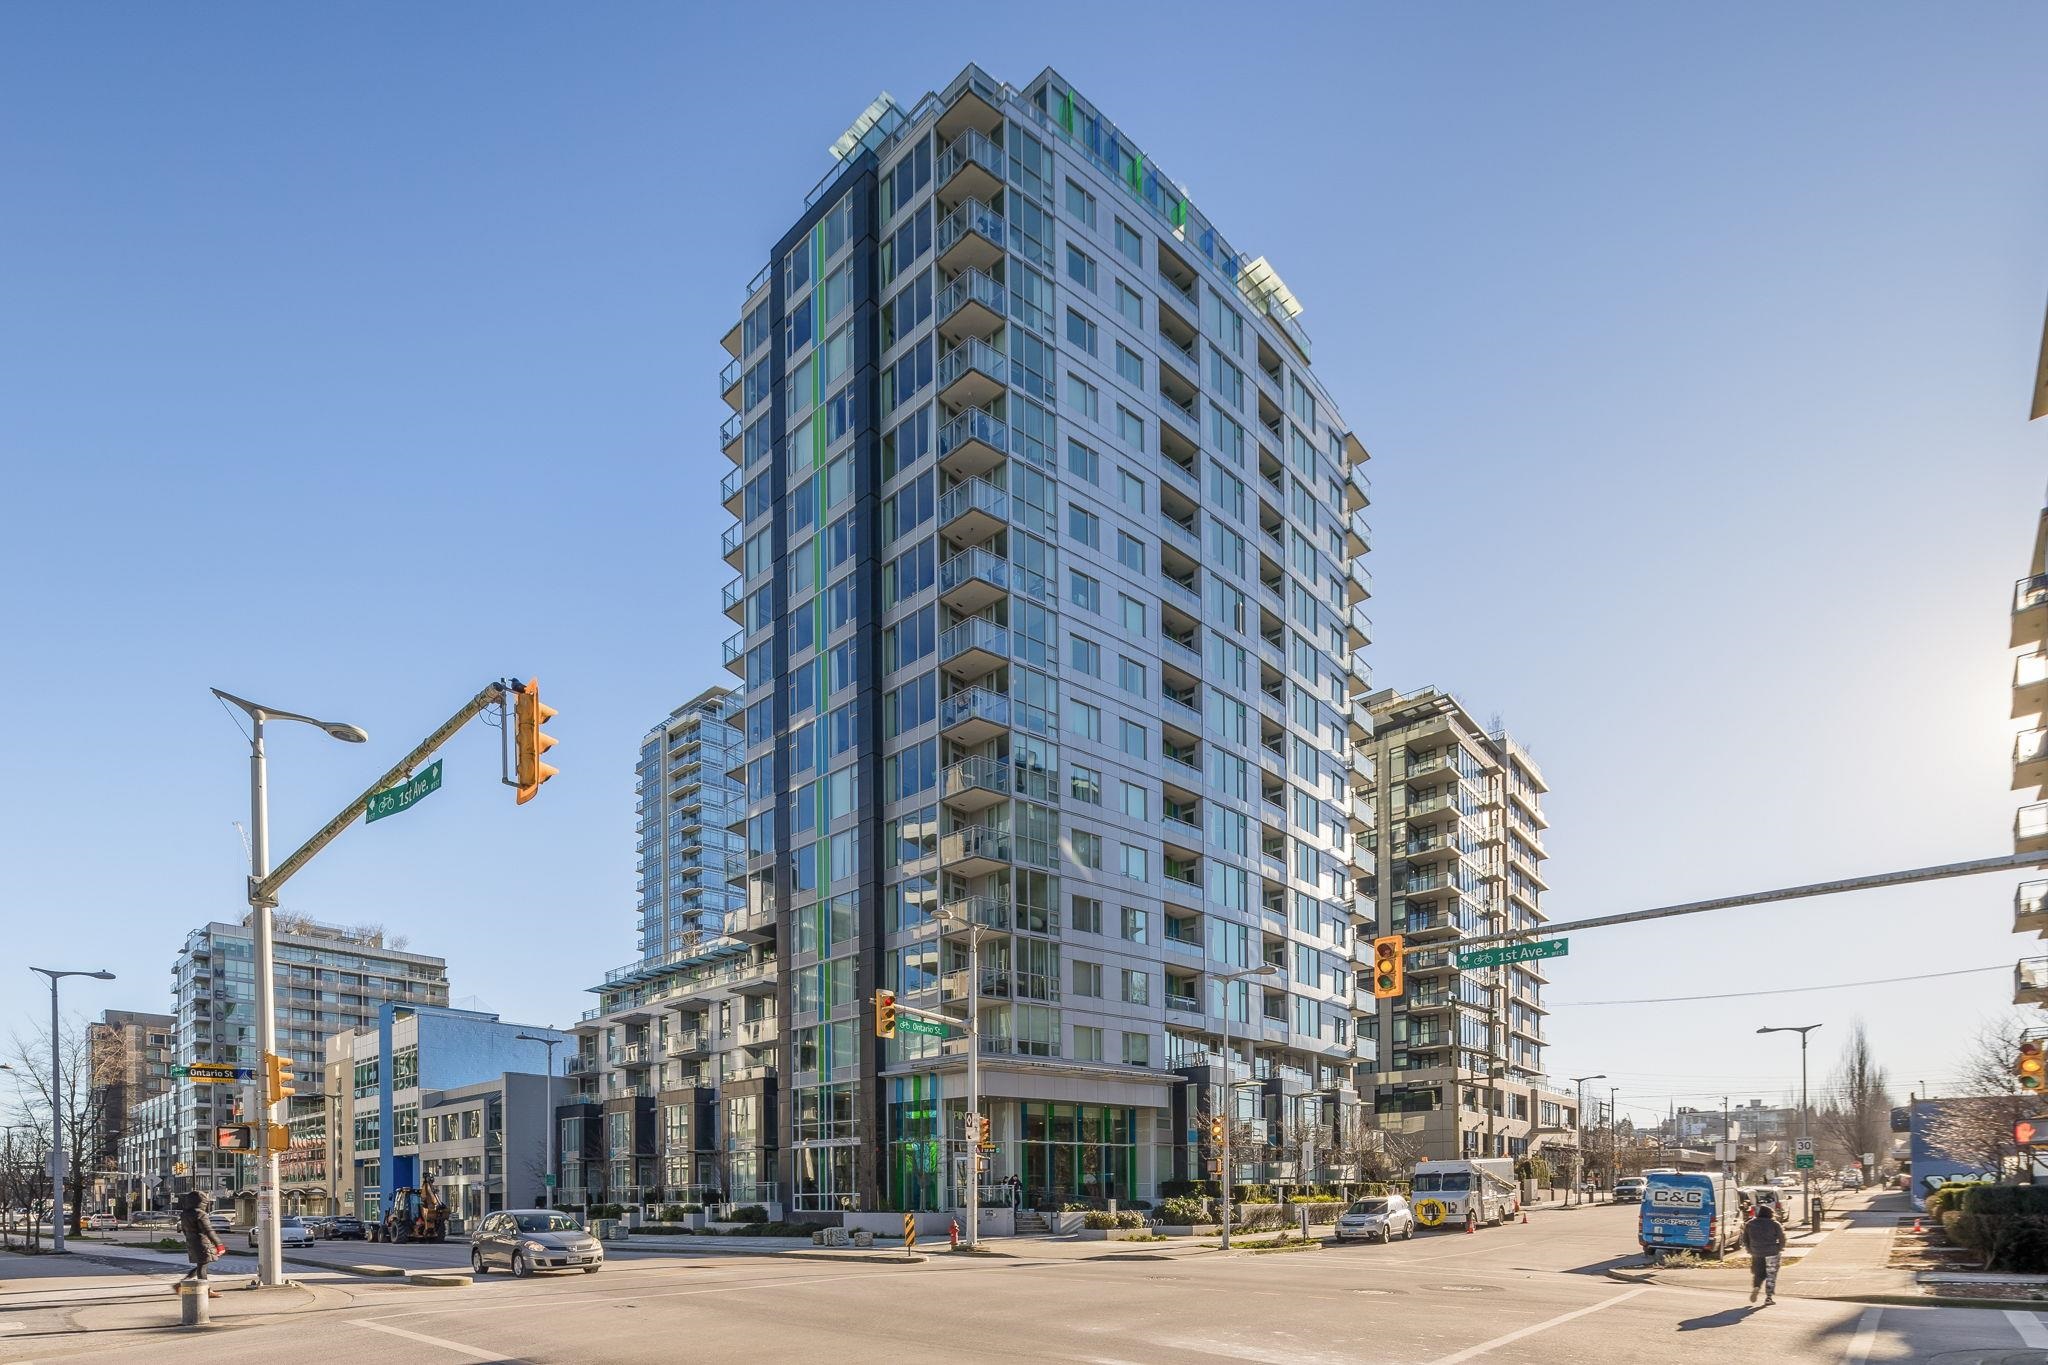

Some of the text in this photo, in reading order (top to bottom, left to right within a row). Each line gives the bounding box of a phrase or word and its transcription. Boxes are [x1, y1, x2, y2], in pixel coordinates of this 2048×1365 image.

[399, 779, 429, 807] 1st Ave.
[1498, 947, 1547, 962] 1st Ave.
[912, 1022, 934, 1034] Ontario
[190, 1068, 223, 1077] Ontario
[224, 1070, 234, 1078] St
[1798, 1141, 1811, 1151] 30
[1654, 1191, 1702, 1203] C&C
